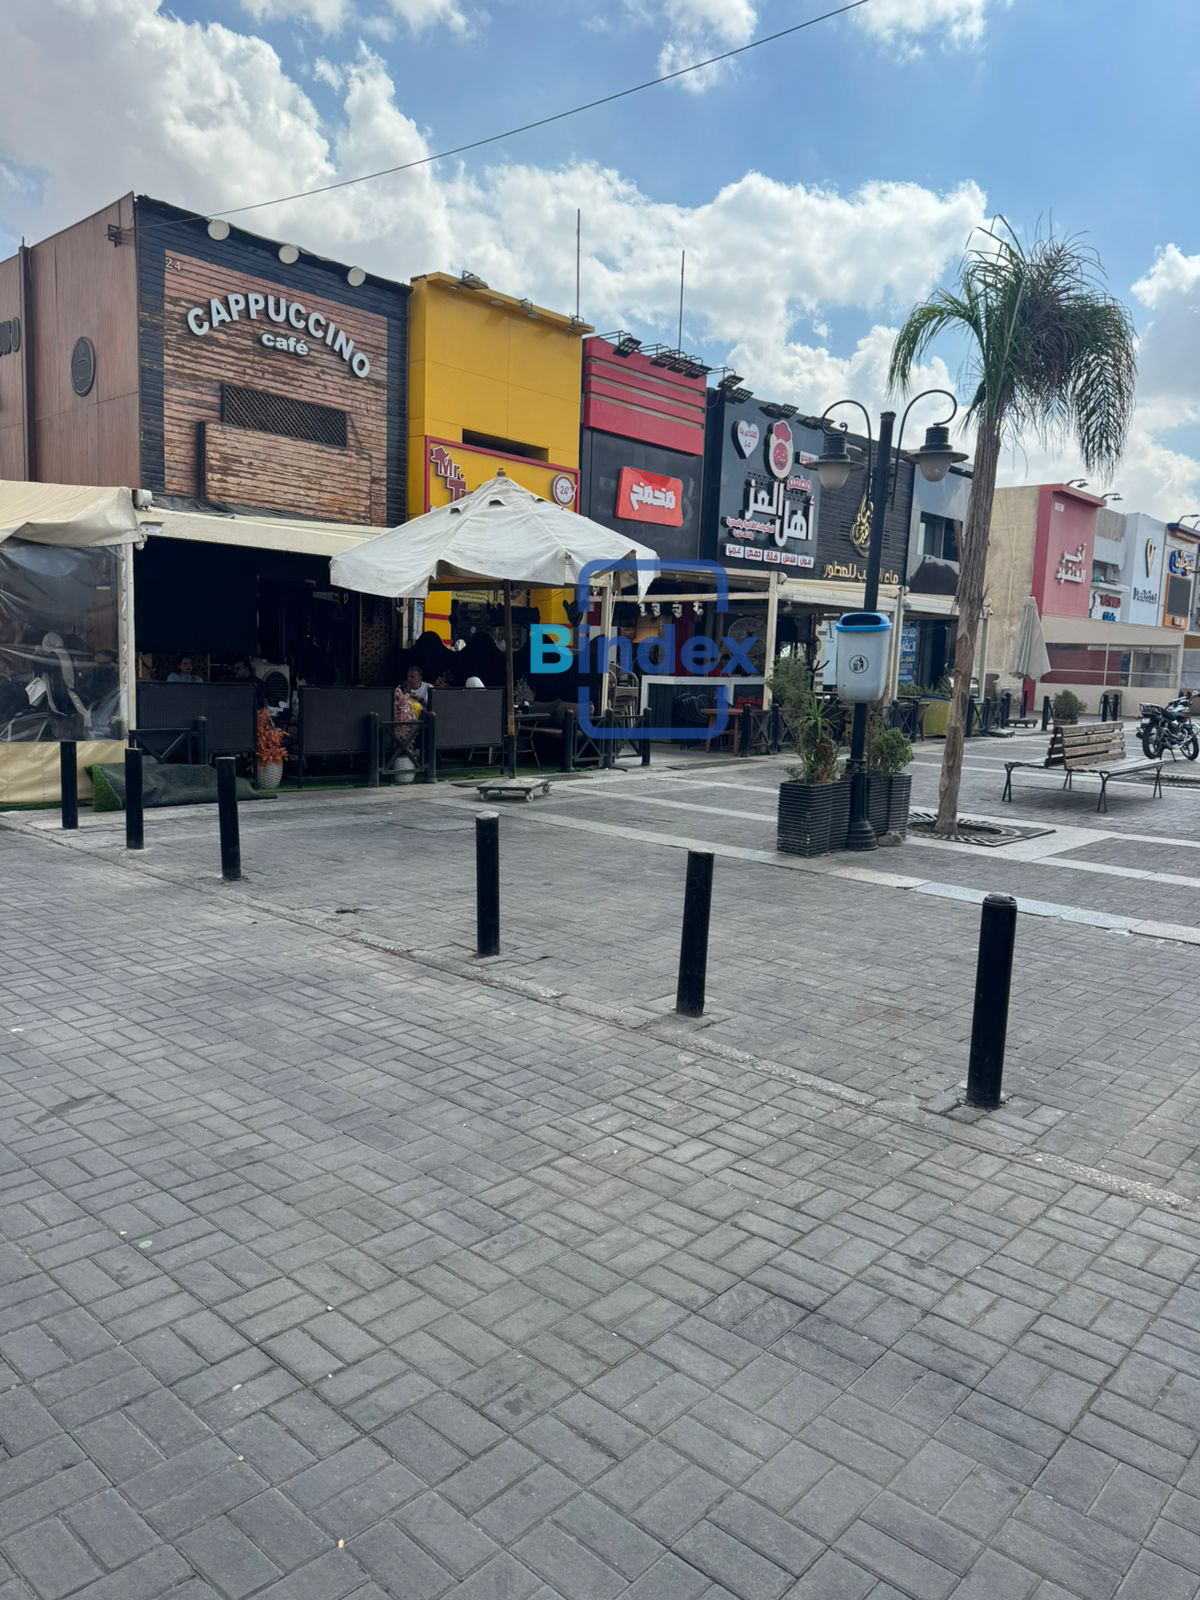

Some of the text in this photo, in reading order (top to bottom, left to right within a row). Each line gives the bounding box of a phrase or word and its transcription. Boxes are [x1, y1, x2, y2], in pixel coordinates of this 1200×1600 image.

[165, 256, 182, 272] 24
[186, 292, 371, 379] CAPPUCCINO
[260, 332, 310, 356] café
[438, 458, 465, 480] Mr.
[745, 479, 785, 520] العز
[775, 495, 815, 547] أهل
[823, 560, 857, 579] للعطور
